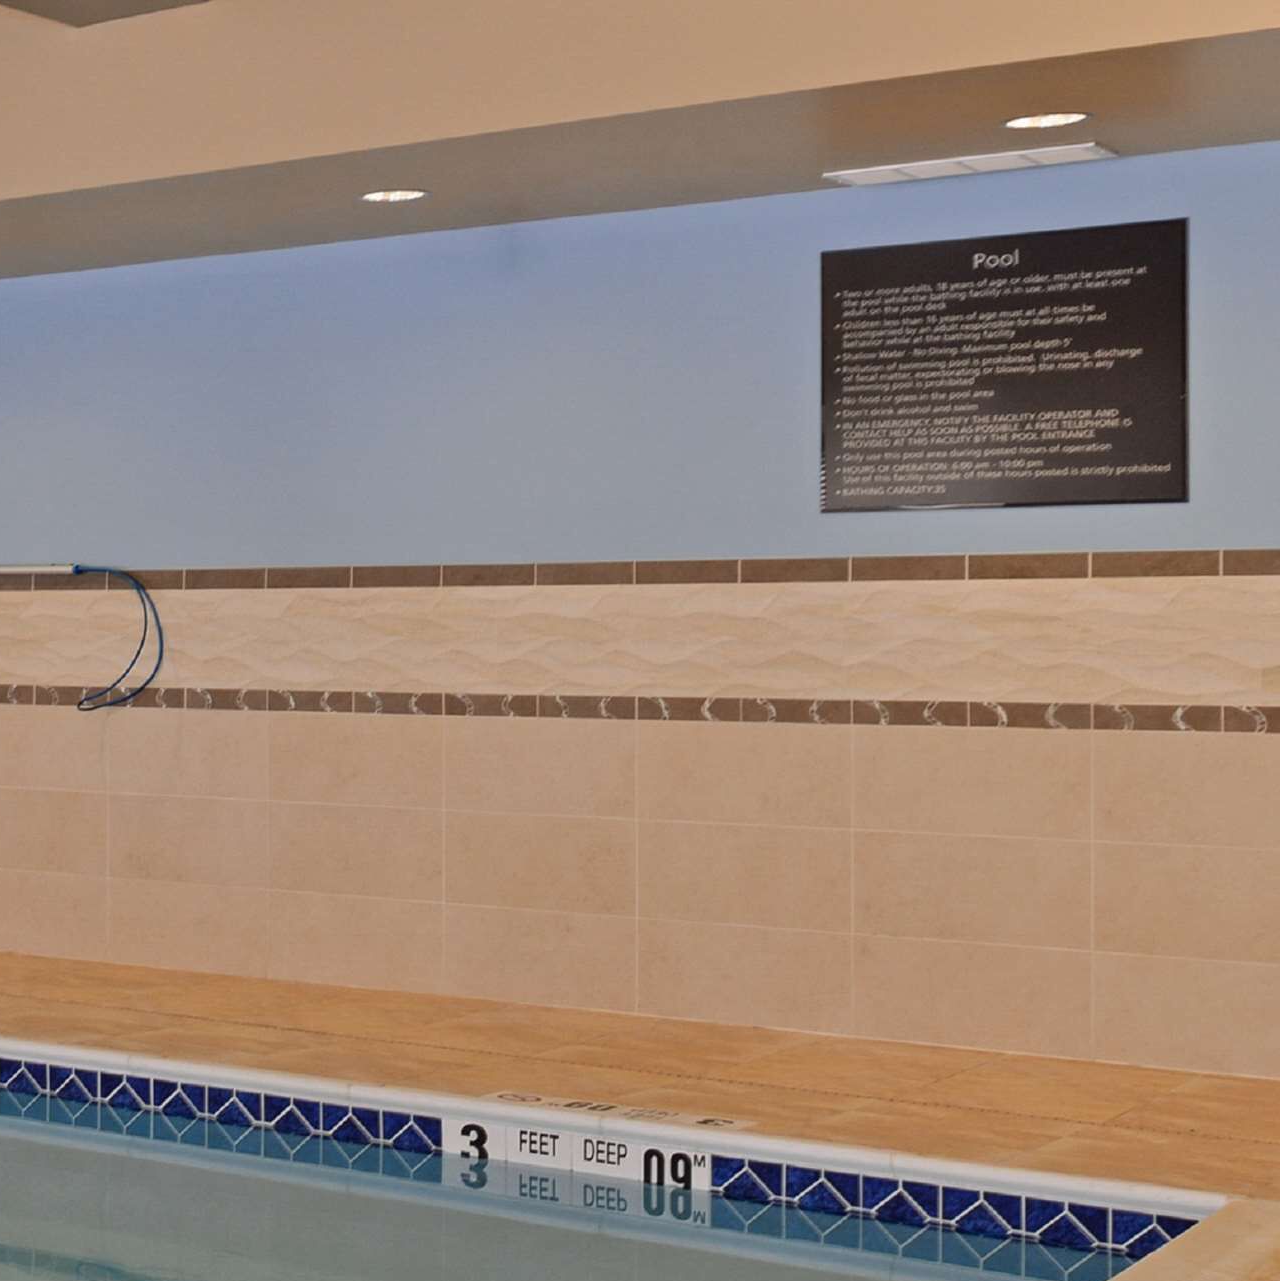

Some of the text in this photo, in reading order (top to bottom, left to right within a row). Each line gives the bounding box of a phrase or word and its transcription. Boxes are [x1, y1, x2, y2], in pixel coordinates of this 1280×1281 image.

[972, 248, 1021, 270] Pool
[842, 289, 861, 300] Two
[875, 287, 900, 297] more
[950, 281, 974, 293] years
[989, 278, 1007, 290] age
[1053, 271, 1078, 283] must
[1096, 266, 1133, 281] present
[842, 298, 858, 309] the
[860, 296, 881, 309] pool
[884, 294, 908, 305] while
[911, 293, 927, 303] the
[929, 289, 966, 304] bathing
[969, 287, 1001, 301] facility
[1047, 281, 1069, 293] with
[1085, 278, 1108, 290] least
[1111, 278, 1130, 288] one
[842, 362, 883, 374] Pollution
[898, 358, 946, 373] swimming
[948, 357, 970, 370] pool
[1094, 346, 1143, 361] discharge
[994, 362, 1036, 376] blowing
[1038, 361, 1054, 372] the
[1056, 361, 1081, 371] nose
[1095, 359, 1114, 370] any
[858, 394, 880, 405] food
[894, 392, 917, 404] glass
[930, 390, 946, 401] the
[948, 389, 970, 402] pool
[973, 389, 994, 399] area
[842, 402, 978, 418] Don't drink alcohol and swim
[933, 414, 969, 426] NOTIFY
[972, 413, 989, 424] THE
[992, 411, 1035, 423] FACILITY
[1037, 408, 1092, 421] OPERATOR
[1095, 407, 1119, 418] AND
[842, 428, 886, 439] CONTACT
[888, 426, 913, 437] HELP
[930, 424, 958, 435] SOON
[1035, 419, 1057, 430] FREE
[1061, 416, 1119, 429] TELEPHONE
[842, 437, 890, 449] PROVIDED
[907, 435, 928, 446] THIS
[930, 433, 972, 445] FACILITY
[991, 432, 1007, 442] THE
[1010, 430, 1038, 441] POOL
[1041, 428, 1094, 440] ENTRANCE
[842, 451, 864, 463] Only
[865, 452, 881, 461] use
[884, 450, 900, 460] this
[902, 449, 924, 461] pool
[926, 449, 947, 458] area
[949, 446, 982, 459] during
[983, 445, 1016, 458] posted
[1019, 444, 1046, 454] hours
[1062, 441, 1112, 455] operation
[842, 463, 875, 474] HOURS
[842, 474, 859, 483] Use
[874, 472, 890, 482] this
[892, 471, 923, 483] facility
[925, 470, 960, 481] outside
[976, 468, 1002, 479] these
[1004, 467, 1032, 478] hours
[1034, 466, 1068, 479] posted
[1080, 464, 1113, 477] strictly
[1116, 462, 1170, 476] prohibited
[842, 486, 883, 496] BATHING
[460, 1124, 489, 1161] 3
[519, 1130, 559, 1157] FEET
[583, 1139, 628, 1166] DEEP
